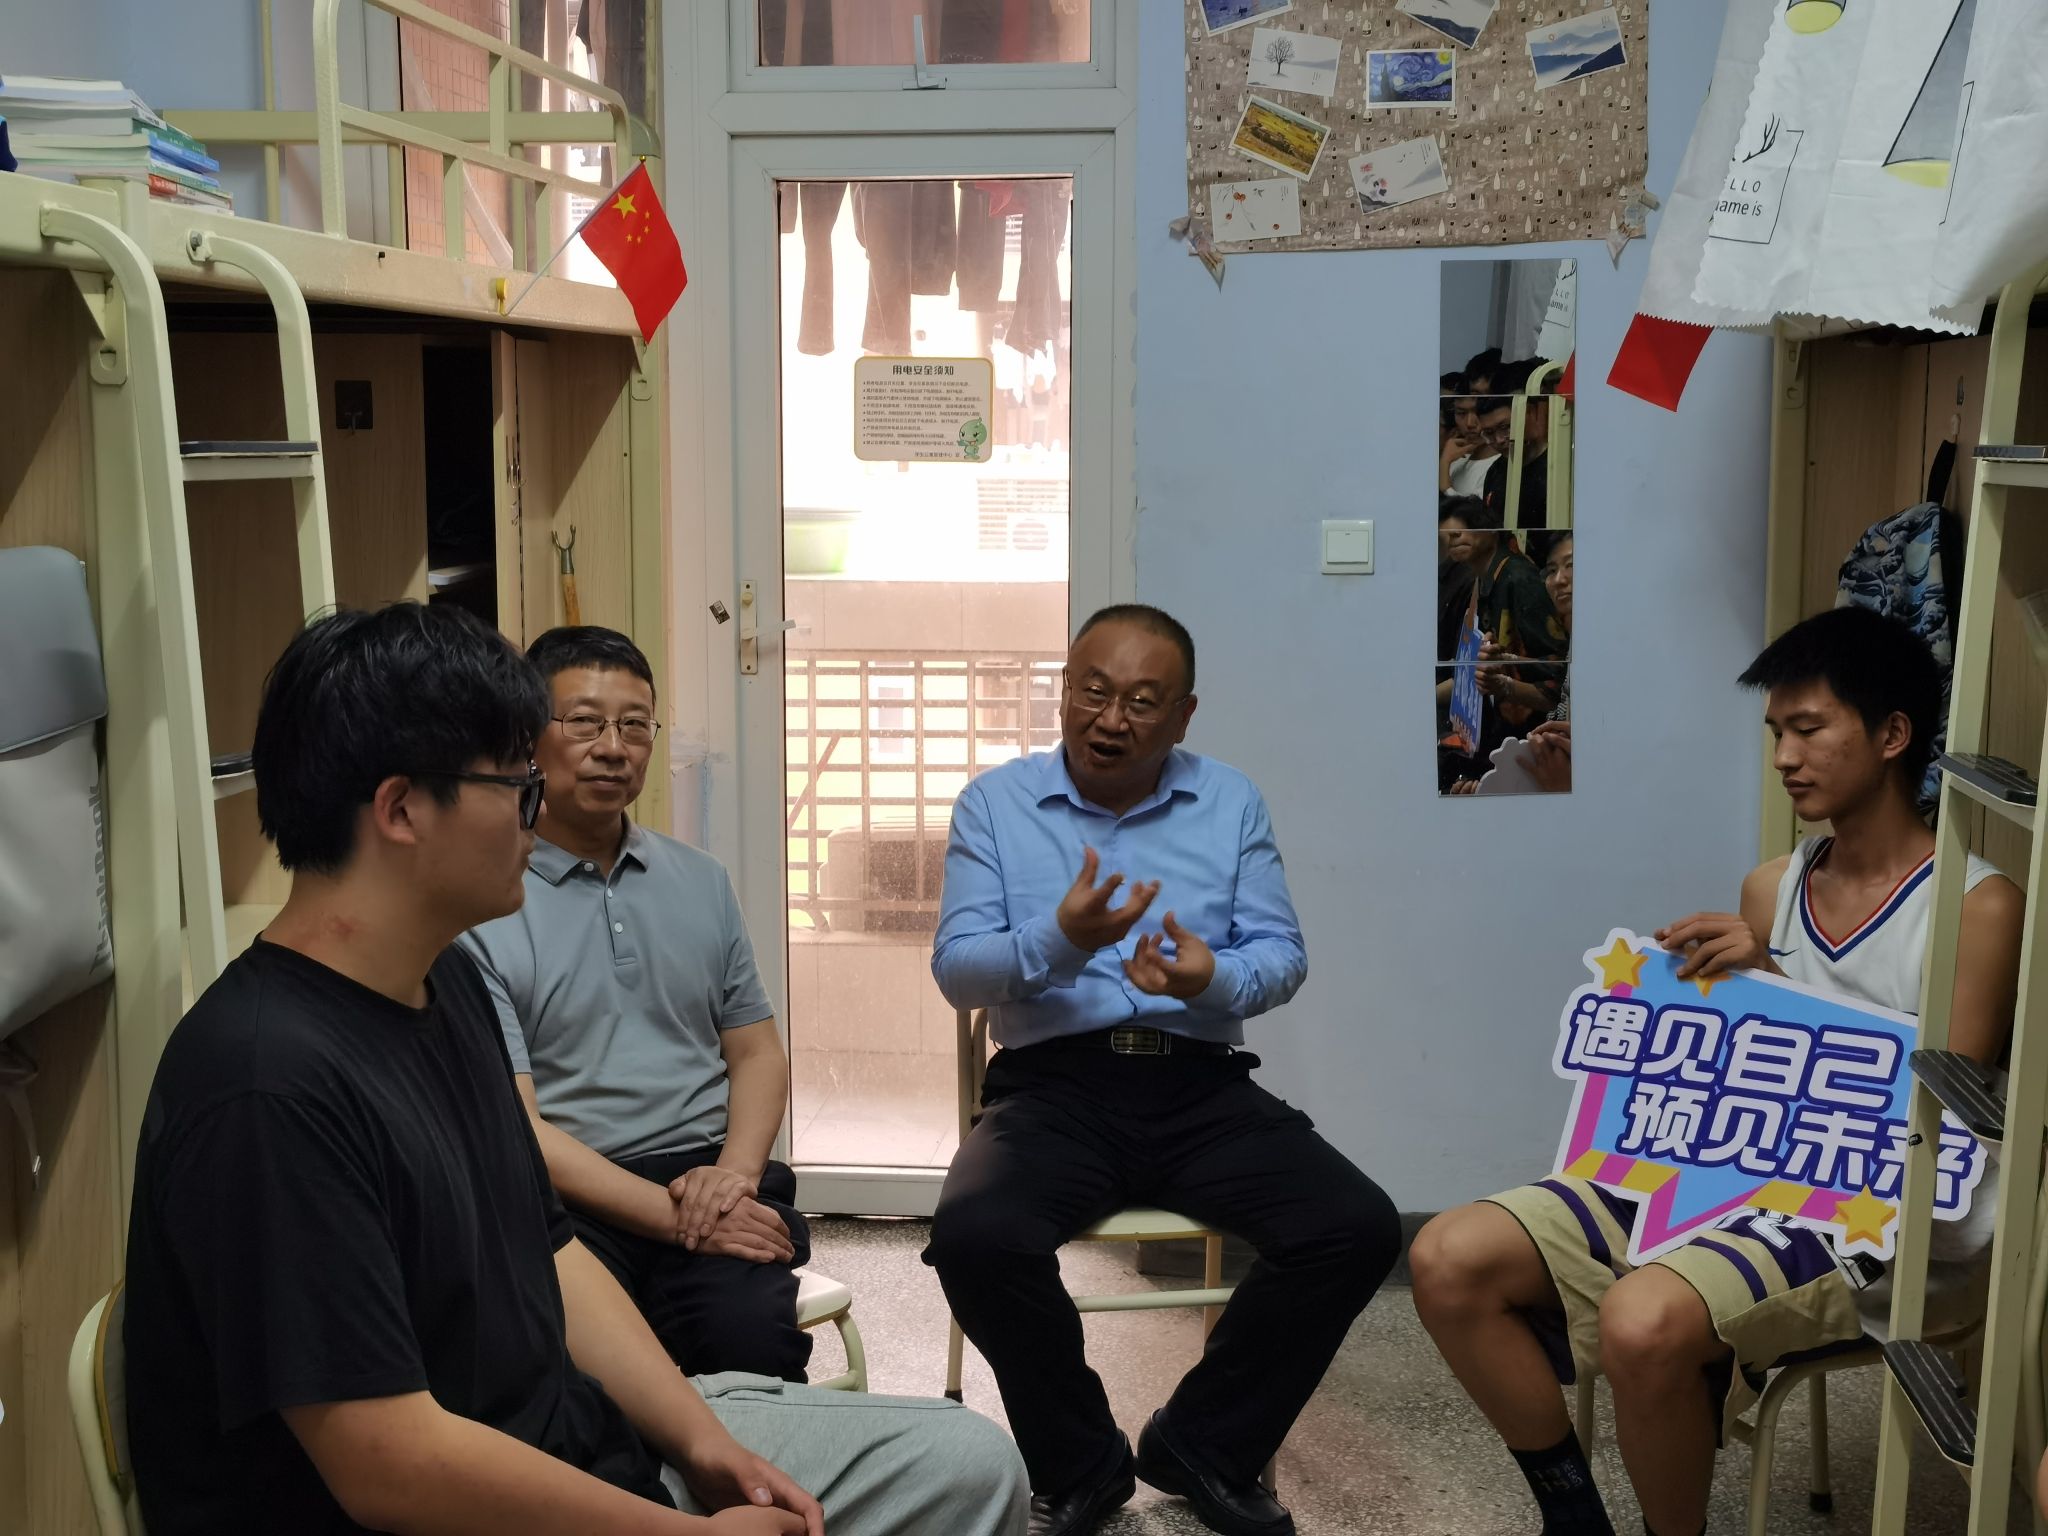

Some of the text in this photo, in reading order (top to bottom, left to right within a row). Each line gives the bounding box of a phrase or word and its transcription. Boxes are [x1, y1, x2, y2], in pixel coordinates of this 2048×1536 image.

[1752, 201, 1762, 216] is
[892, 364, 955, 376] 用电安全须知
[1567, 999, 1898, 1108] 遇见自己
